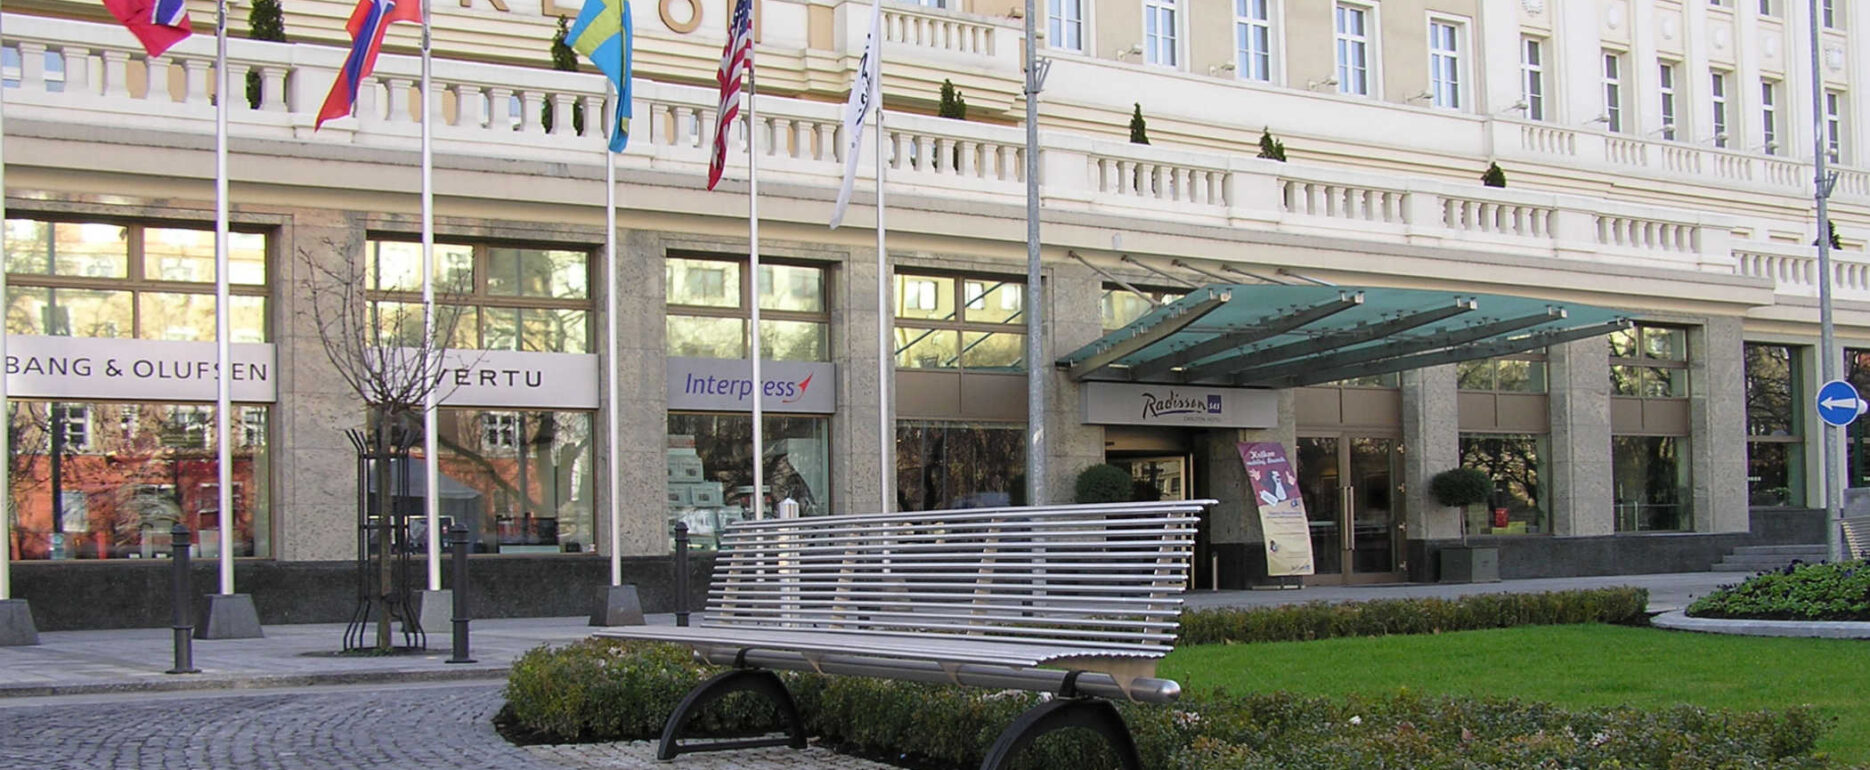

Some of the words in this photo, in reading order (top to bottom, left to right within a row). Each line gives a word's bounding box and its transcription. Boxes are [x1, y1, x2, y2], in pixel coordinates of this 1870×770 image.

[6, 356, 92, 376] BANG
[105, 359, 123, 377] &
[685, 373, 796, 400] Interpess
[1142, 390, 1206, 420] Radisson
